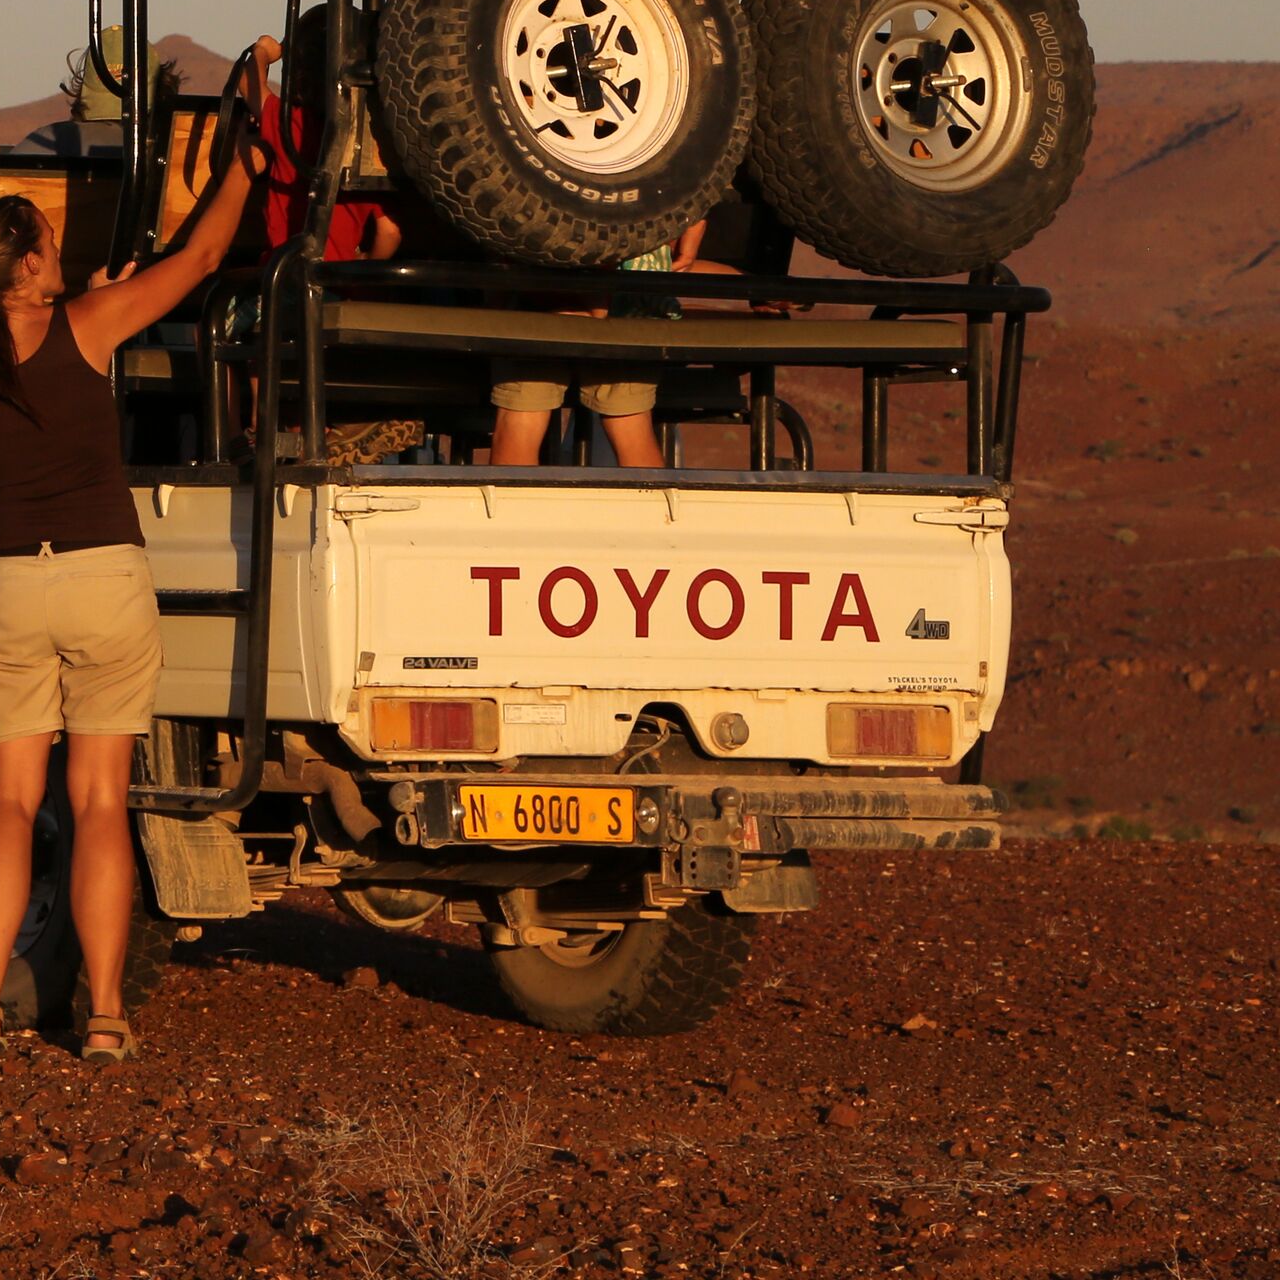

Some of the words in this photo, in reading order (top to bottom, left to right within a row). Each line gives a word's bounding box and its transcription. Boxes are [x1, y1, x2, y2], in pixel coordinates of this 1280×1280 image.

[702, 15, 724, 65] T/A
[1029, 11, 1065, 169] MUDSTAR
[491, 85, 641, 204] BFGoodrich
[470, 566, 880, 643] TOYOTA
[905, 608, 949, 639] 4WD
[404, 658, 426, 669] 24
[428, 658, 478, 669] VALVE
[469, 794, 488, 833] N
[513, 794, 580, 835] 6800
[607, 796, 621, 836] S
